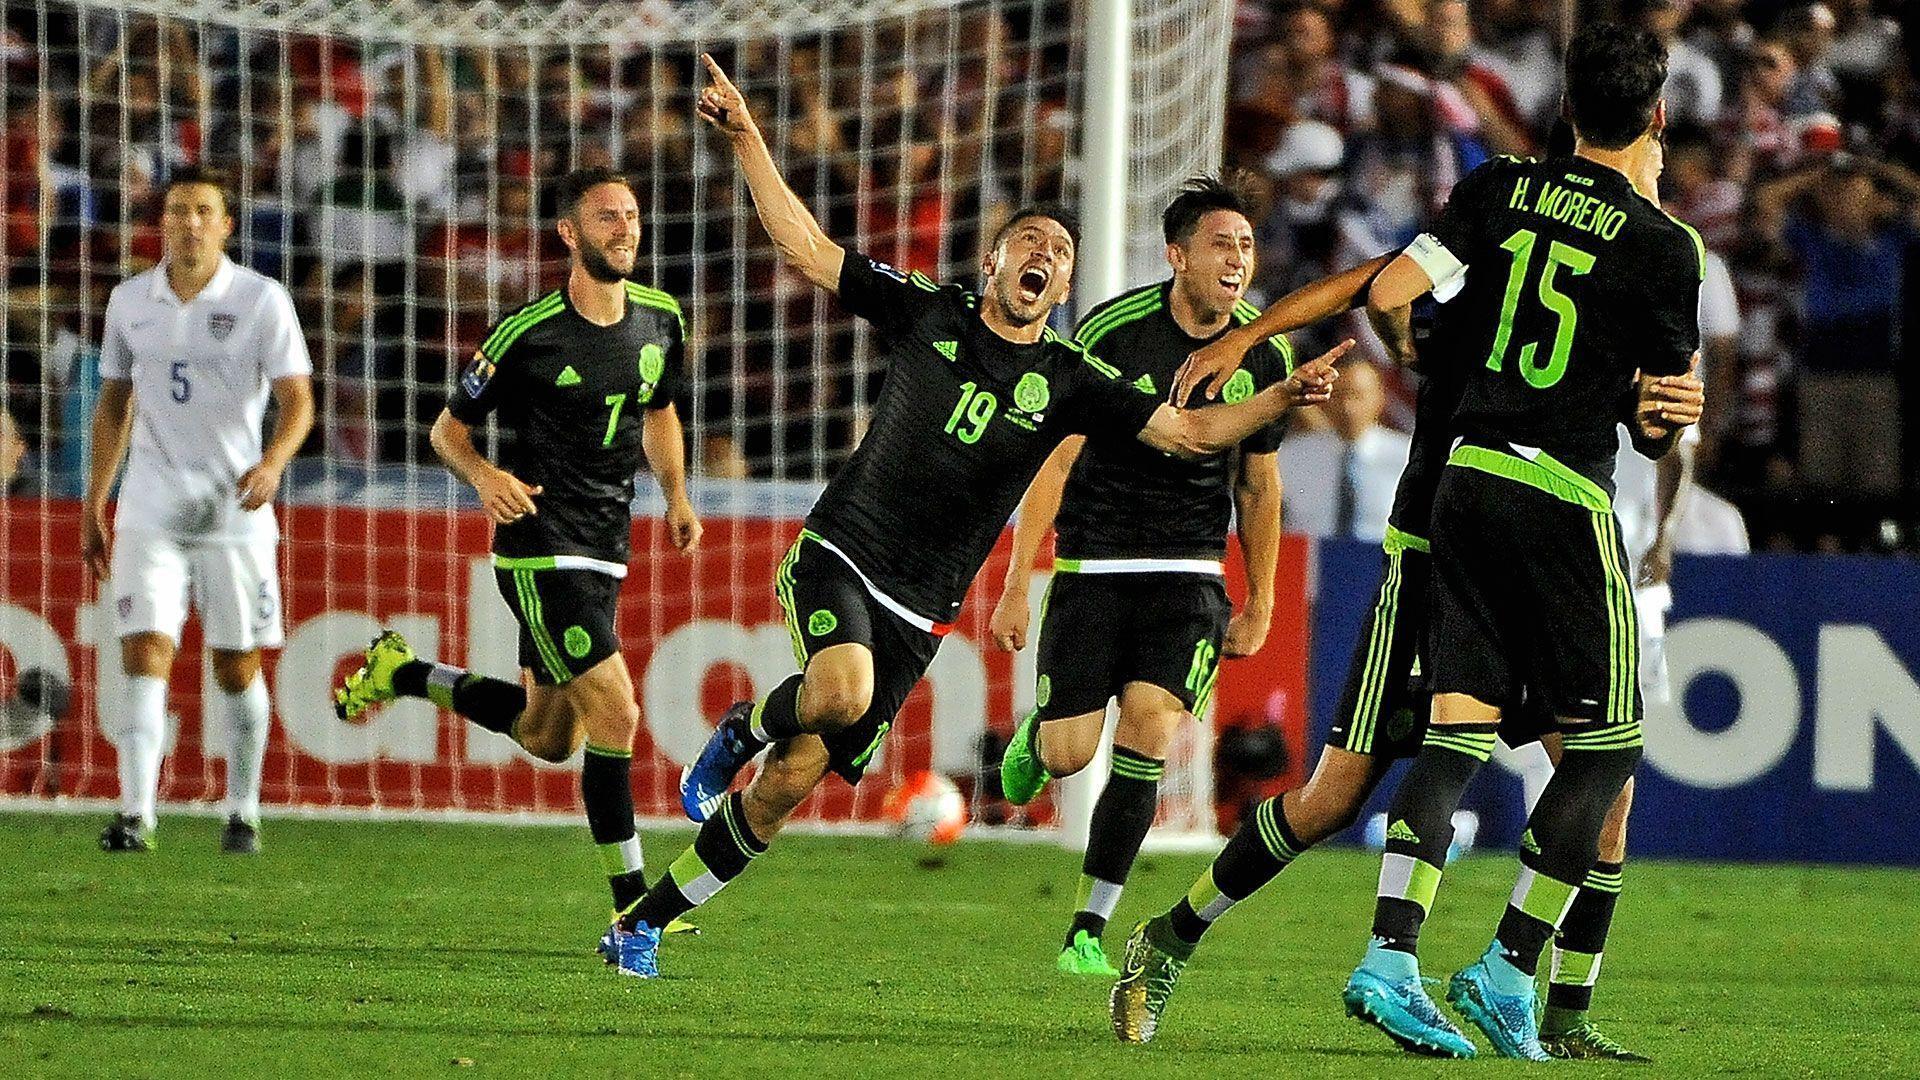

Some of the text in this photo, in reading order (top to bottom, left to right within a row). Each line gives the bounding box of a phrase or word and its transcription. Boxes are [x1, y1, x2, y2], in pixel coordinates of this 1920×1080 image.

[1508, 176, 1628, 241] H. MORENO
[1485, 228, 1597, 389] 15
[170, 359, 192, 404] 5
[943, 381, 998, 444] 19
[602, 393, 627, 447] 7
